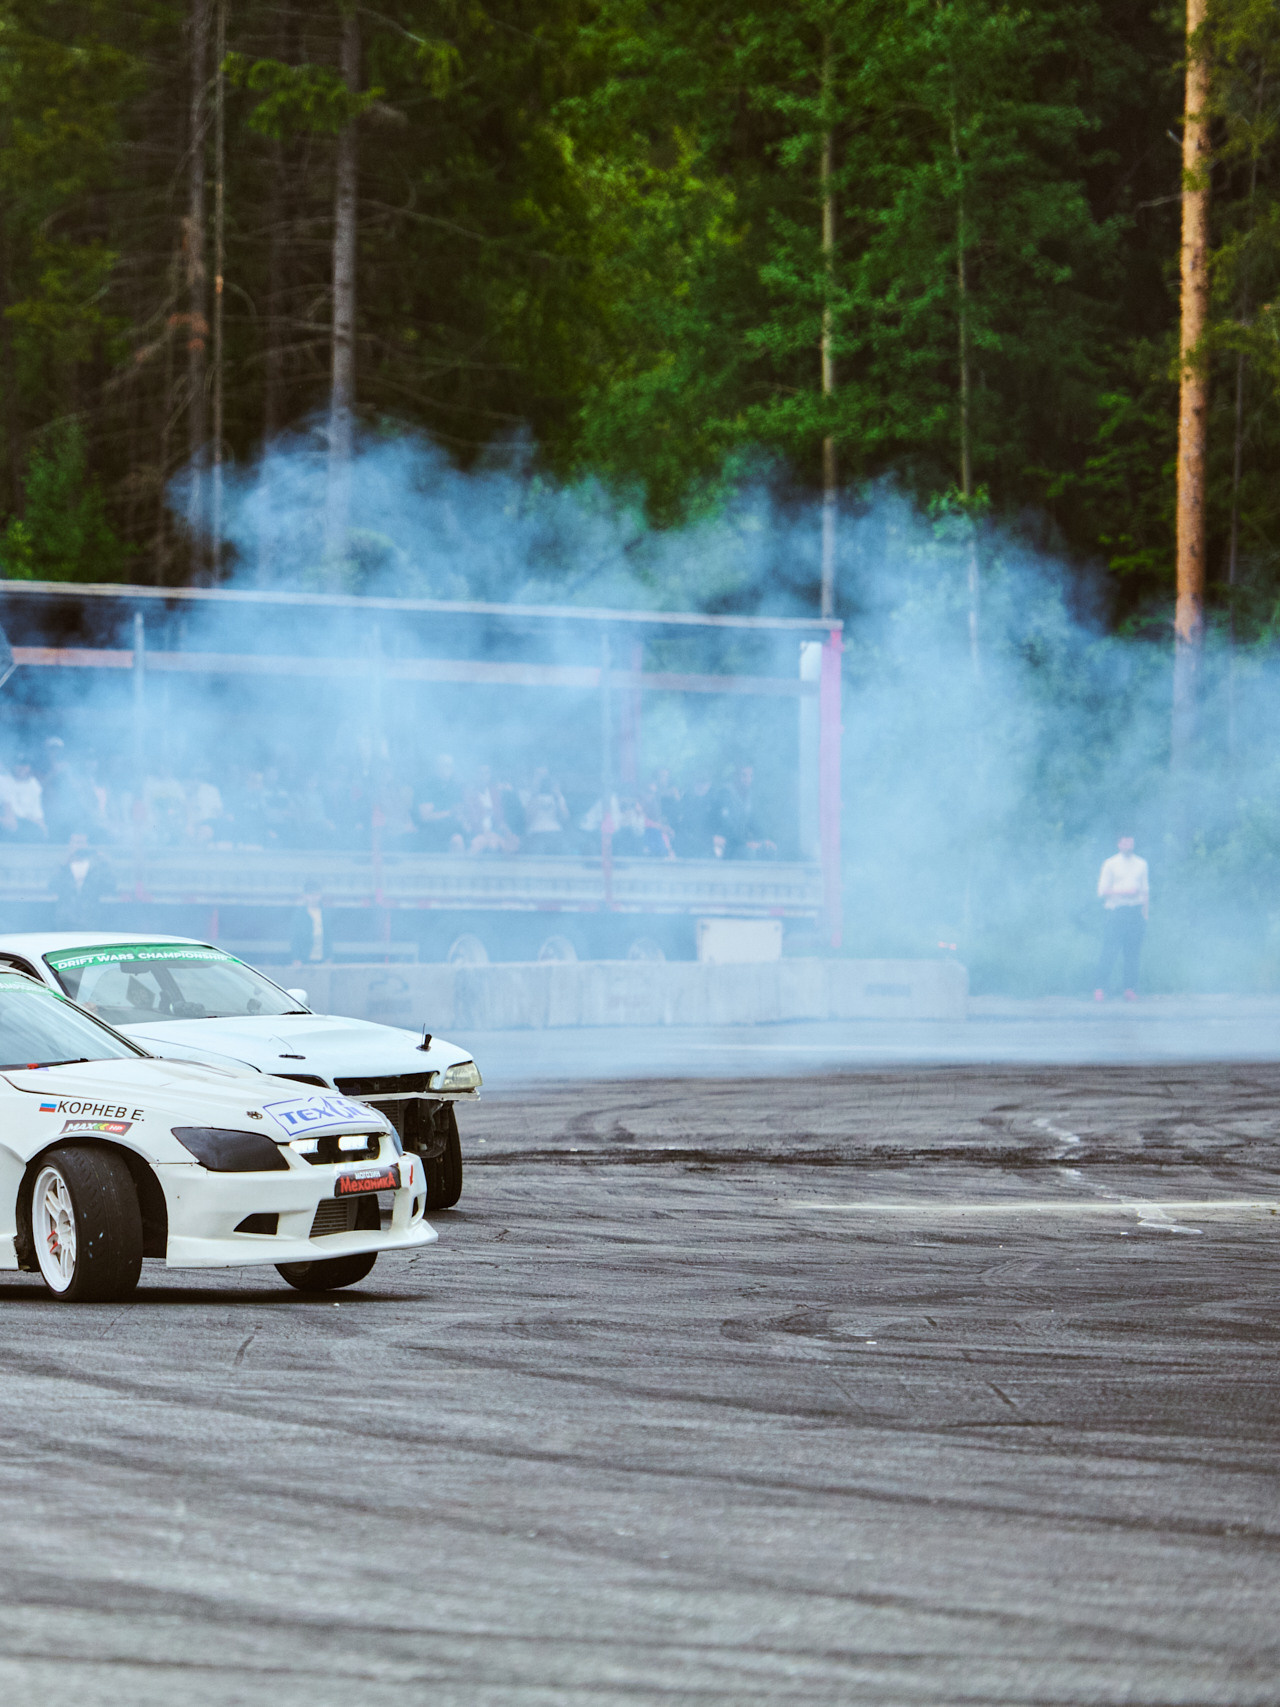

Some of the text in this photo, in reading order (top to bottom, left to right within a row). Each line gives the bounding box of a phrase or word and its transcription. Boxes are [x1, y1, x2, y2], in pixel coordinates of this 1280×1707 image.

[57, 956, 94, 969] DRIFT
[96, 953, 134, 962] WARS
[57, 1100, 128, 1119] КОРНЕВ
